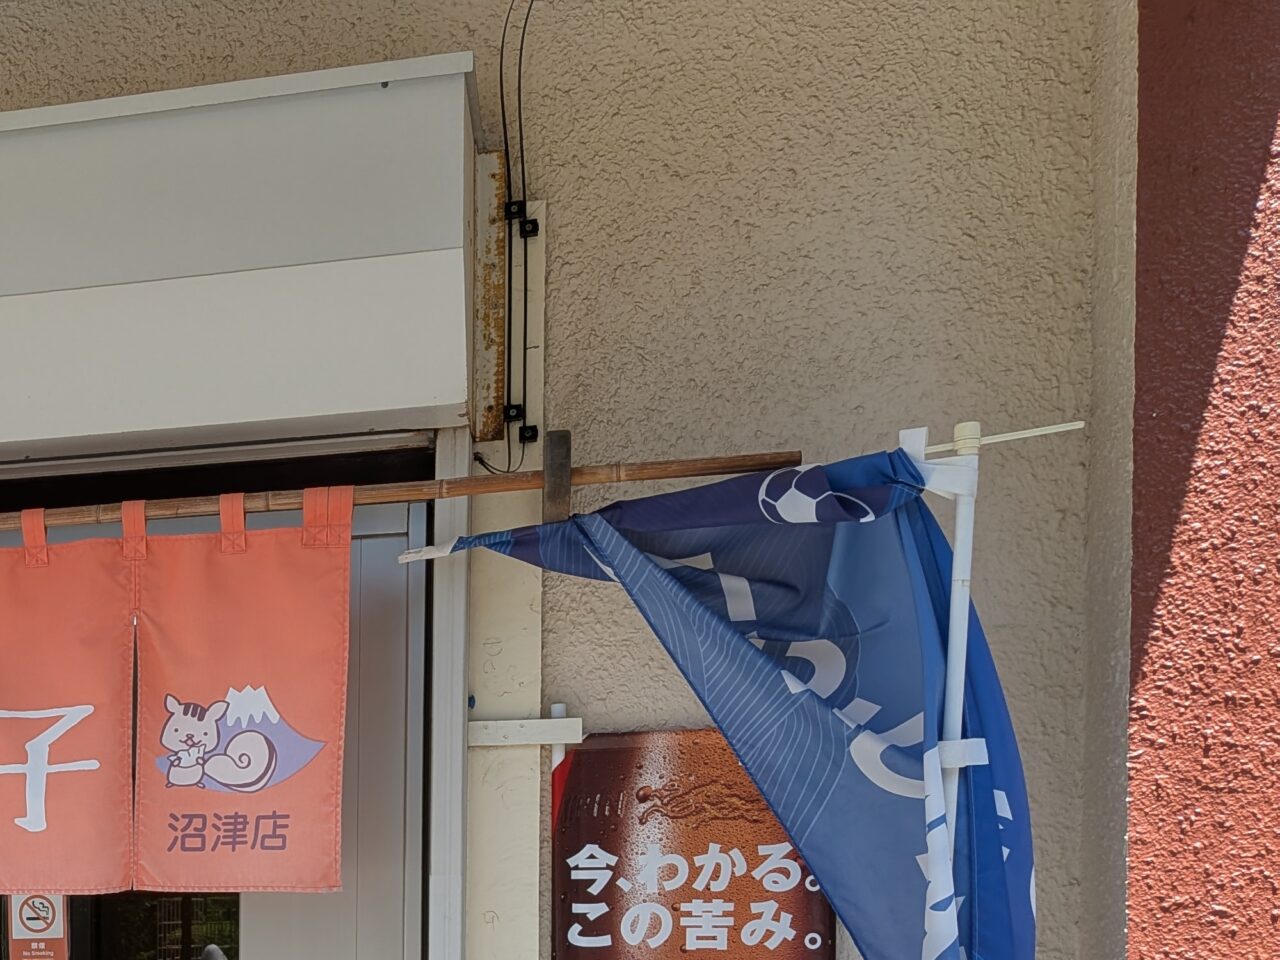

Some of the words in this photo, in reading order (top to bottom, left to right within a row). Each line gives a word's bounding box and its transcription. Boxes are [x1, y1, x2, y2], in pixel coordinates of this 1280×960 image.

[166, 810, 290, 853] 沼津店
[566, 842, 822, 895] 今、わかる。
[567, 899, 822, 950] この苦み。
